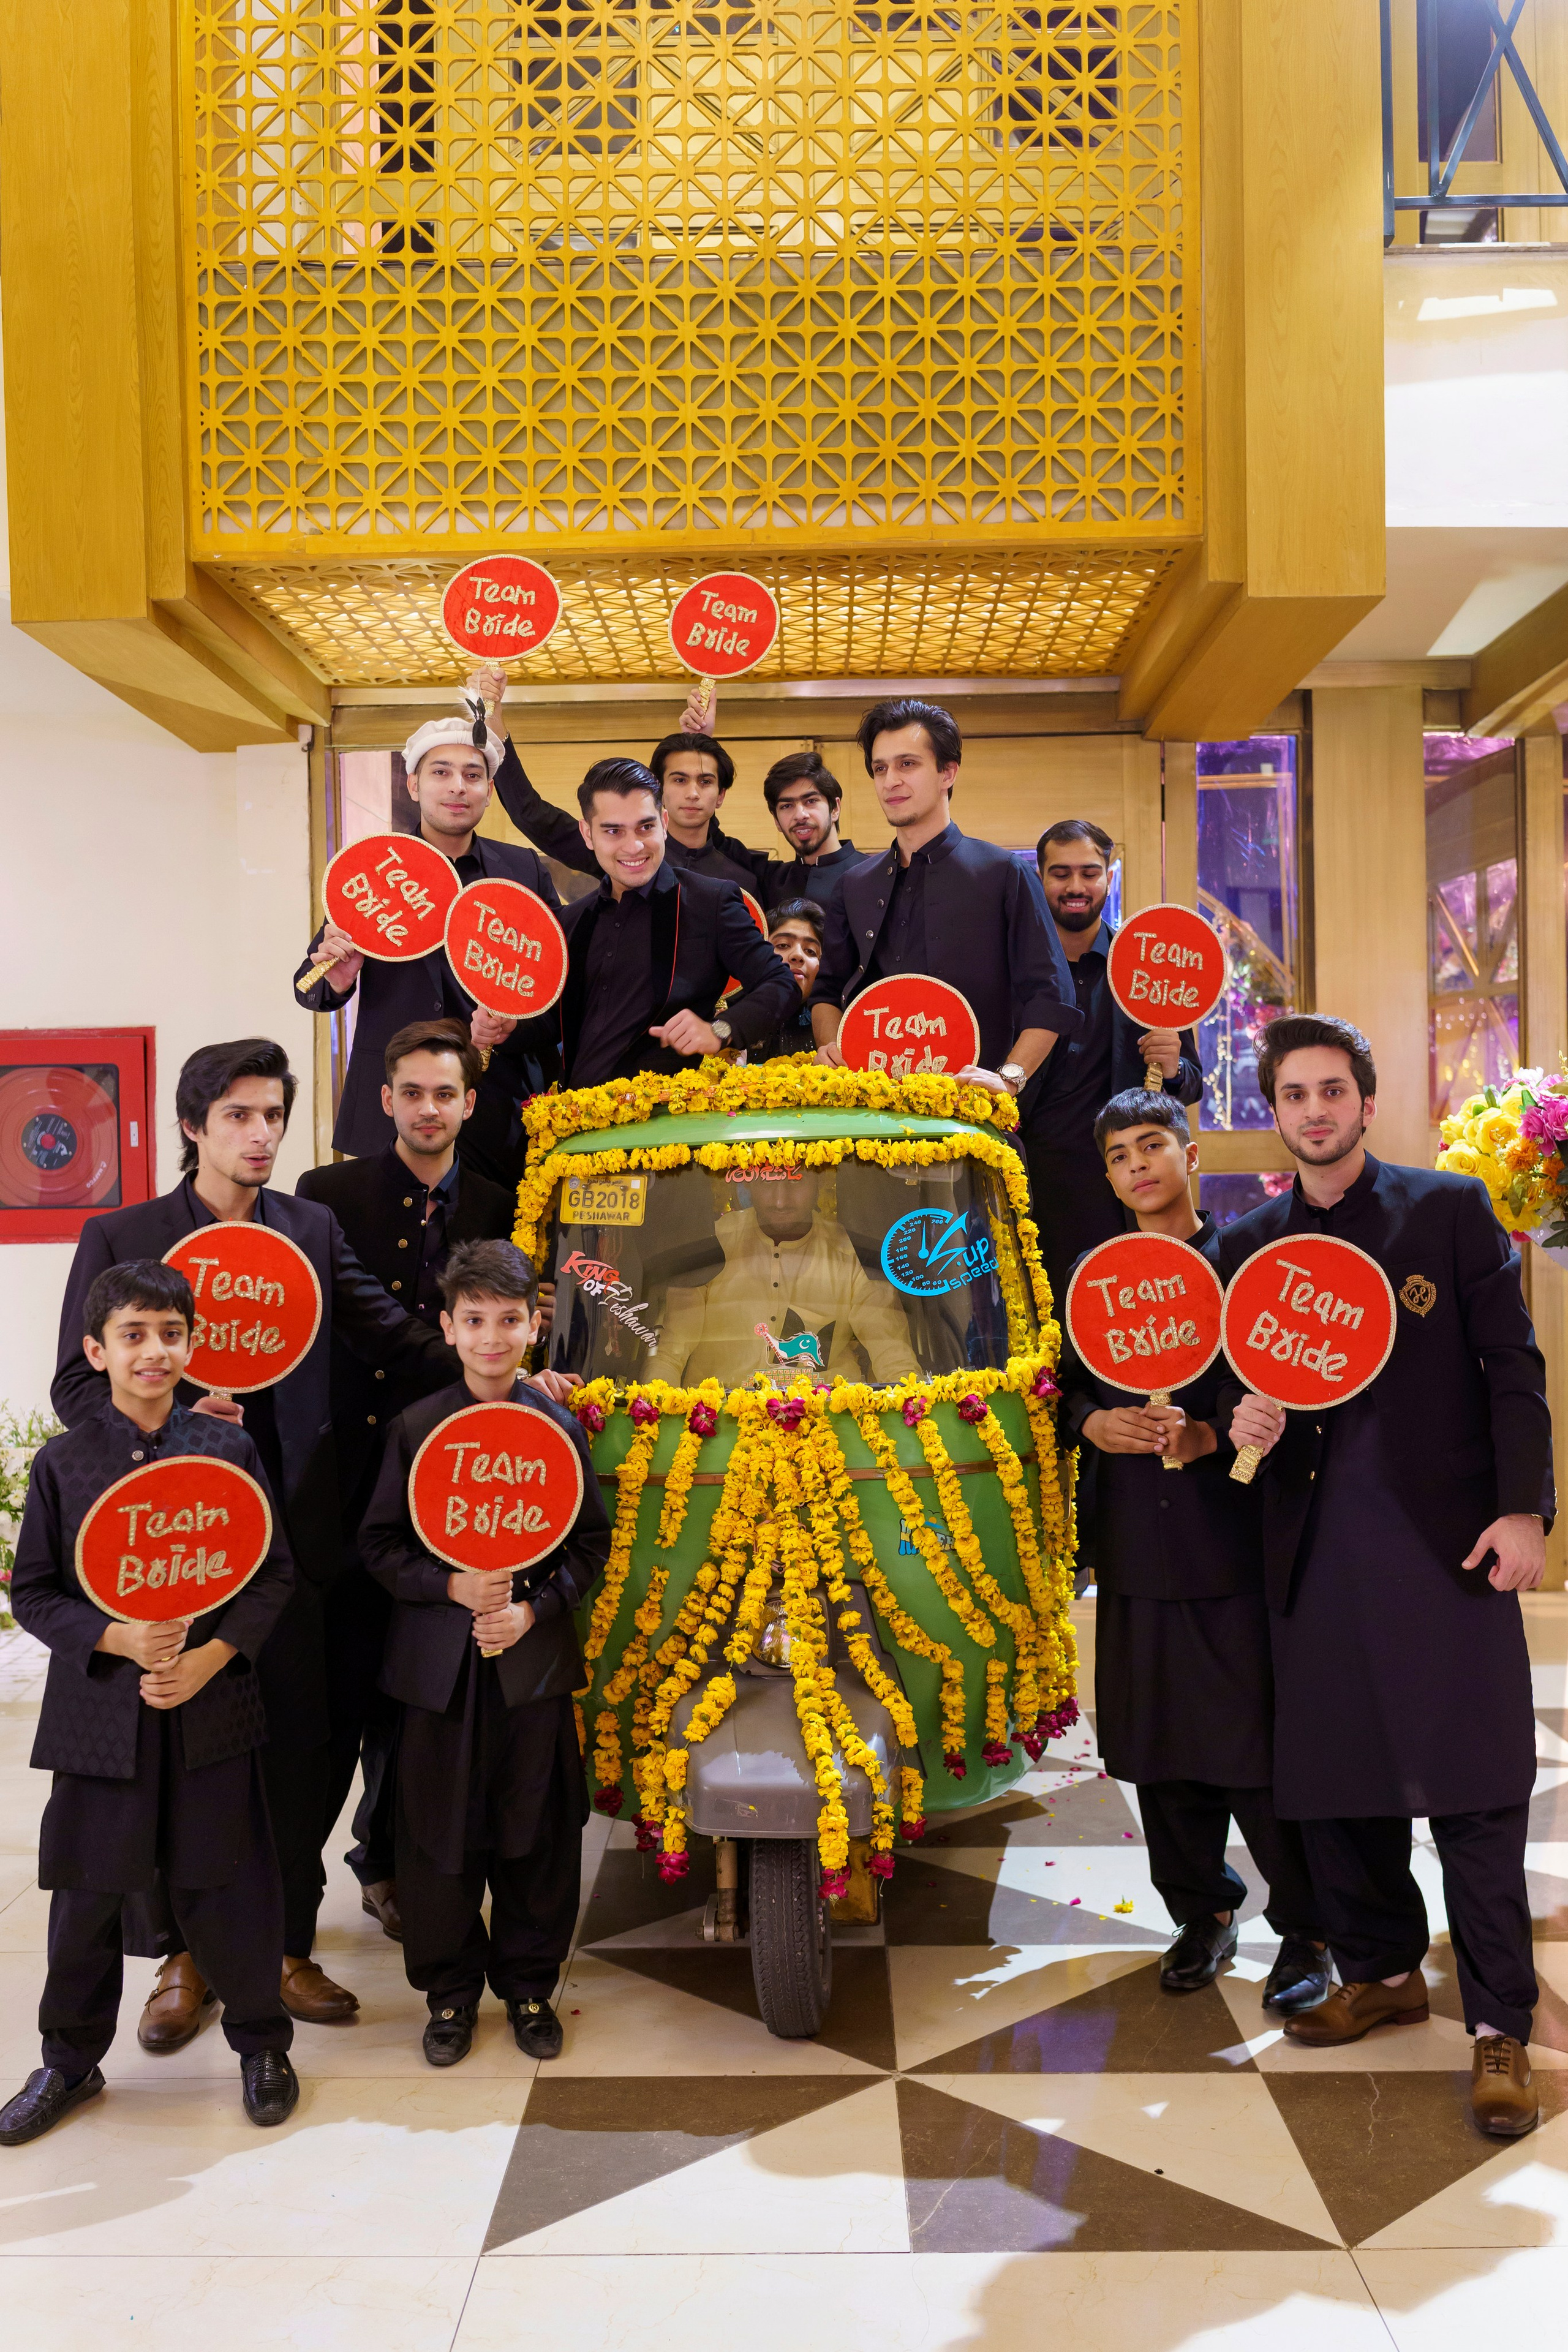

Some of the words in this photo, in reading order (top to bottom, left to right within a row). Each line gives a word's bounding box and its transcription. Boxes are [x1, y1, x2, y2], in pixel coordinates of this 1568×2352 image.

[467, 576, 536, 606] Team
[700, 590, 758, 624] Team
[375, 846, 435, 921] Team
[473, 900, 542, 962] Team
[1133, 932, 1203, 970] Team
[864, 1006, 948, 1039] Team
[568, 1191, 639, 1209] GB2018
[573, 1211, 630, 1221] PESHAWAR
[188, 1257, 285, 1306] Team
[949, 1257, 999, 1290] speed
[1086, 1275, 1186, 1317] Team
[1276, 1259, 1364, 1330] Team
[444, 1441, 546, 1486] Team
[117, 1501, 230, 1546] Team
